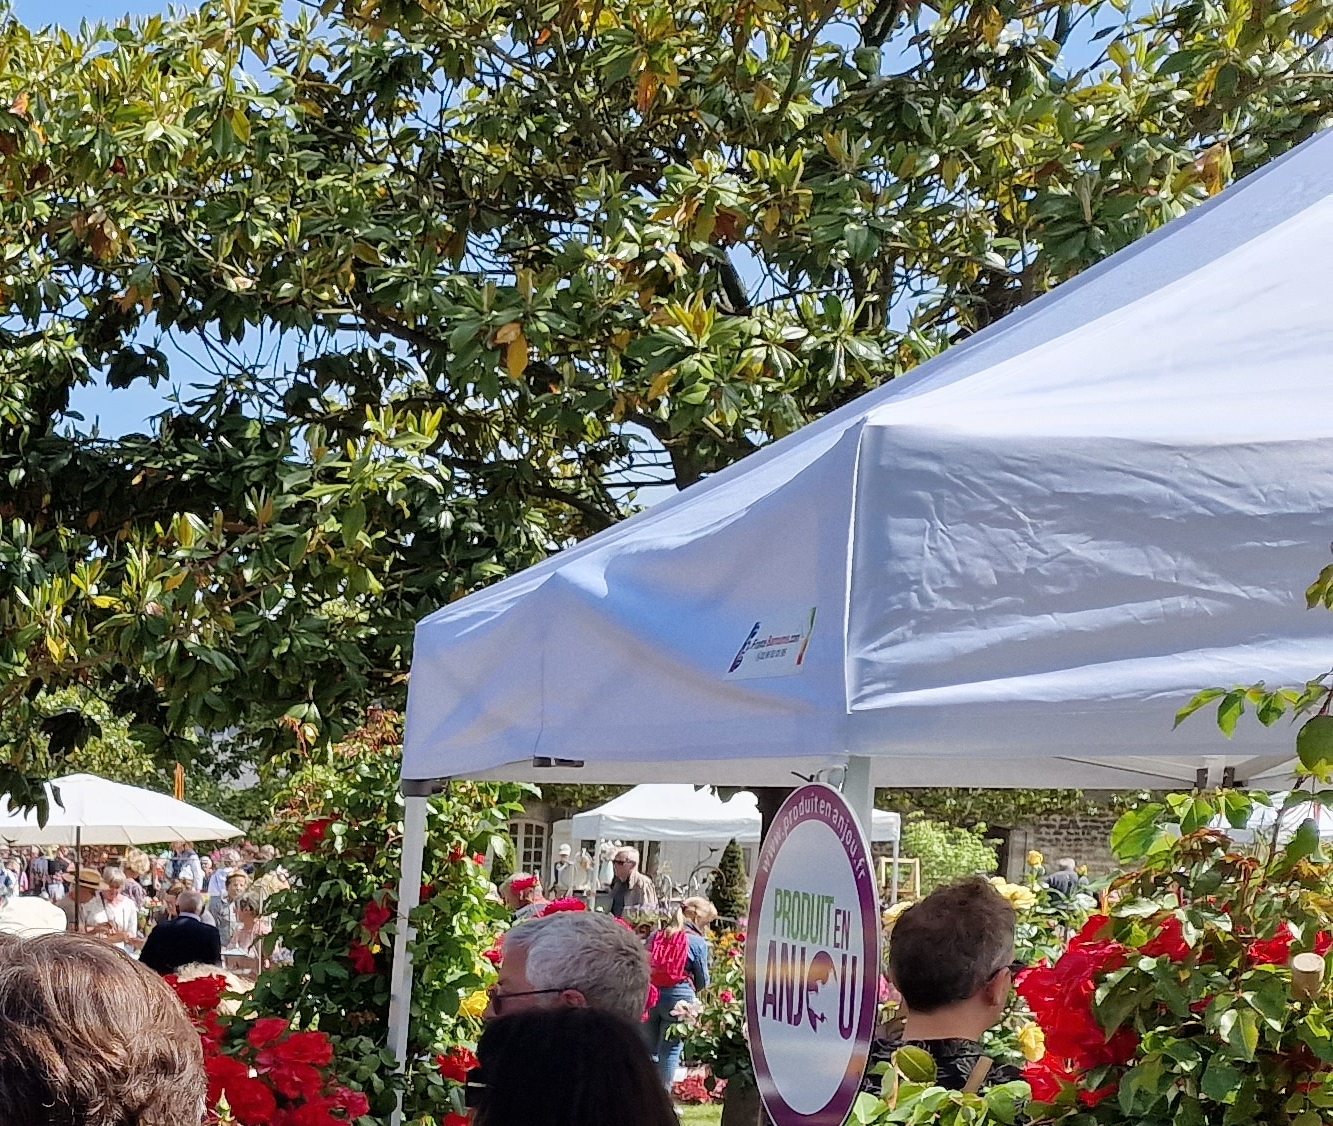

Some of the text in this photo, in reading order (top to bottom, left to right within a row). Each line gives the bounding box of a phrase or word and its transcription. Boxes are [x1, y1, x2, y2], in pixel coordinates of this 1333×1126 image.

[762, 791, 866, 880] www.produitenanjou.fr
[773, 887, 851, 951] PRODUIT EN
